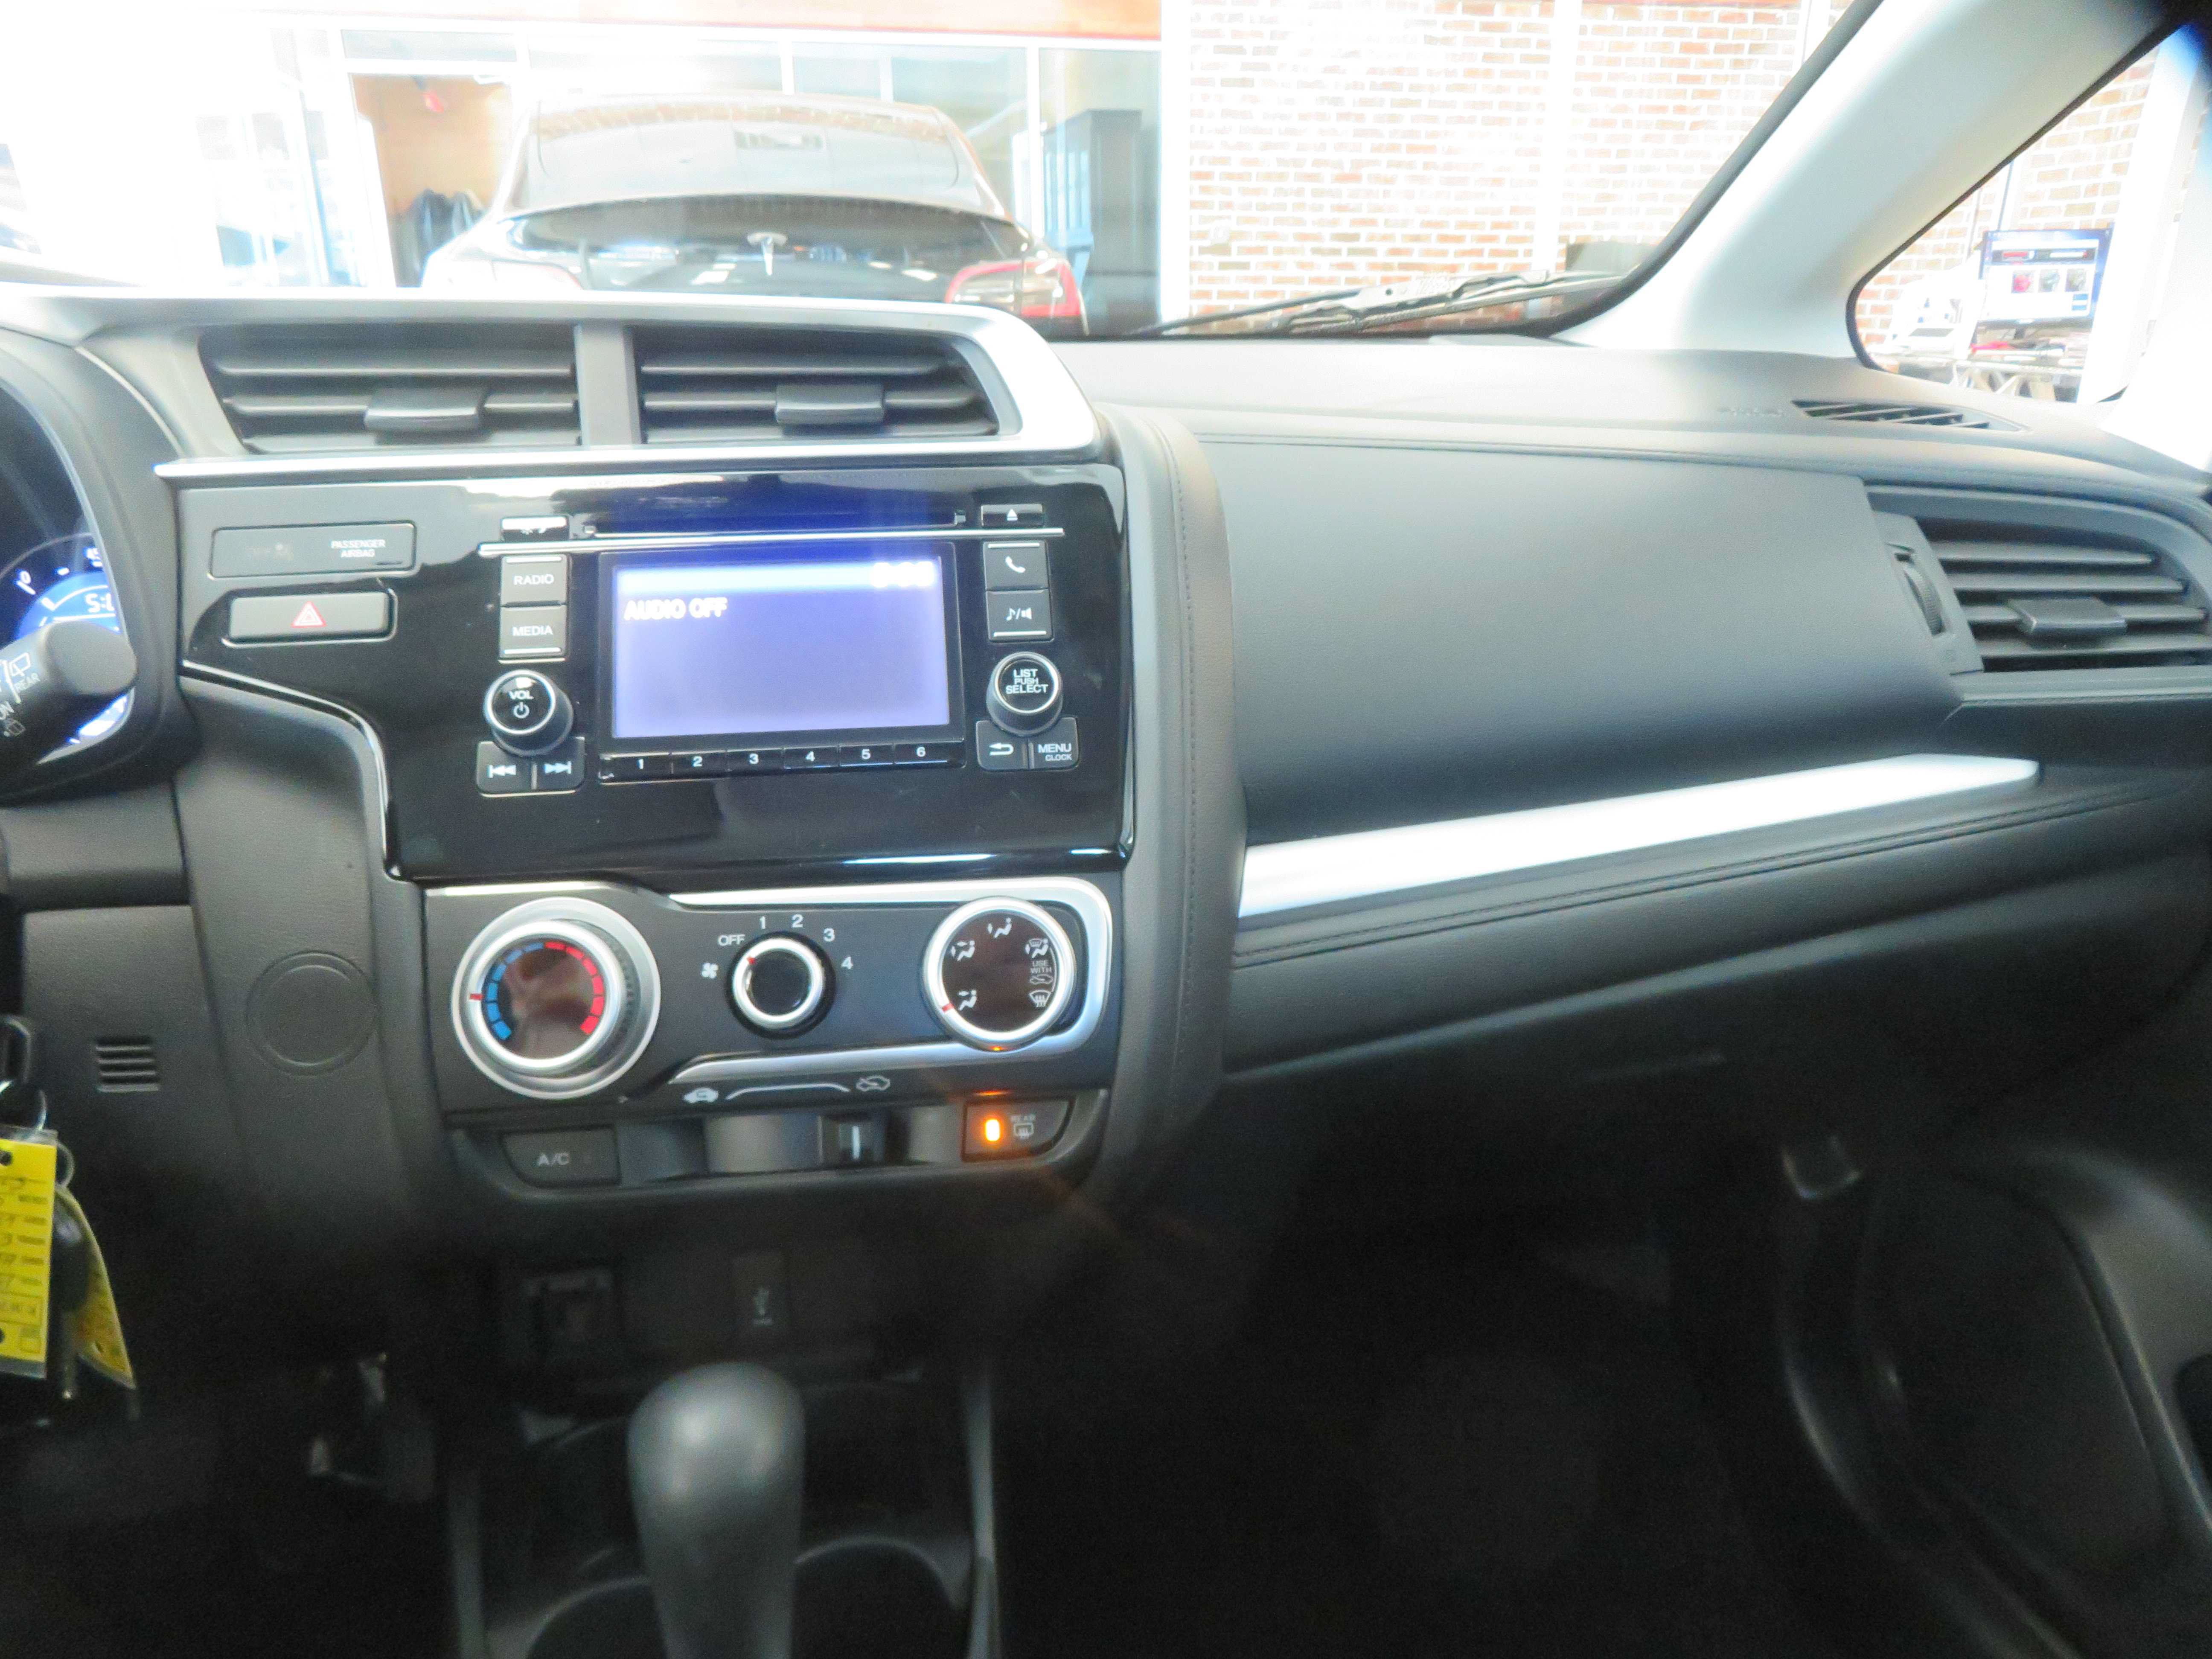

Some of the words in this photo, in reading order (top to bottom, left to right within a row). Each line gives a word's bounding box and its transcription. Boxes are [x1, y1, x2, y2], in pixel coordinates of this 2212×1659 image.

[331, 539, 386, 549] PASSENGER
[341, 549, 375, 557] AIRBAG
[514, 573, 554, 585] RADIO
[624, 599, 686, 620] AUDIO
[689, 597, 728, 618] OFF
[512, 625, 553, 636] MEDIA
[1013, 668, 1039, 678] LIST
[509, 690, 534, 700] VOL
[1005, 684, 1048, 695] SELECT
[917, 746, 926, 757] 6
[1038, 743, 1072, 754] MENU
[749, 753, 759, 764] 3
[806, 751, 815, 762] 4
[862, 749, 871, 760] 5
[1045, 753, 1073, 762] CLOCK
[638, 759, 644, 769] 1
[693, 756, 703, 767] 2
[760, 916, 766, 929] 1
[791, 914, 804, 928] 2
[718, 934, 745, 946] OFF
[824, 928, 835, 942] 3
[841, 956, 854, 970] 4
[538, 1152, 570, 1165] A/C
